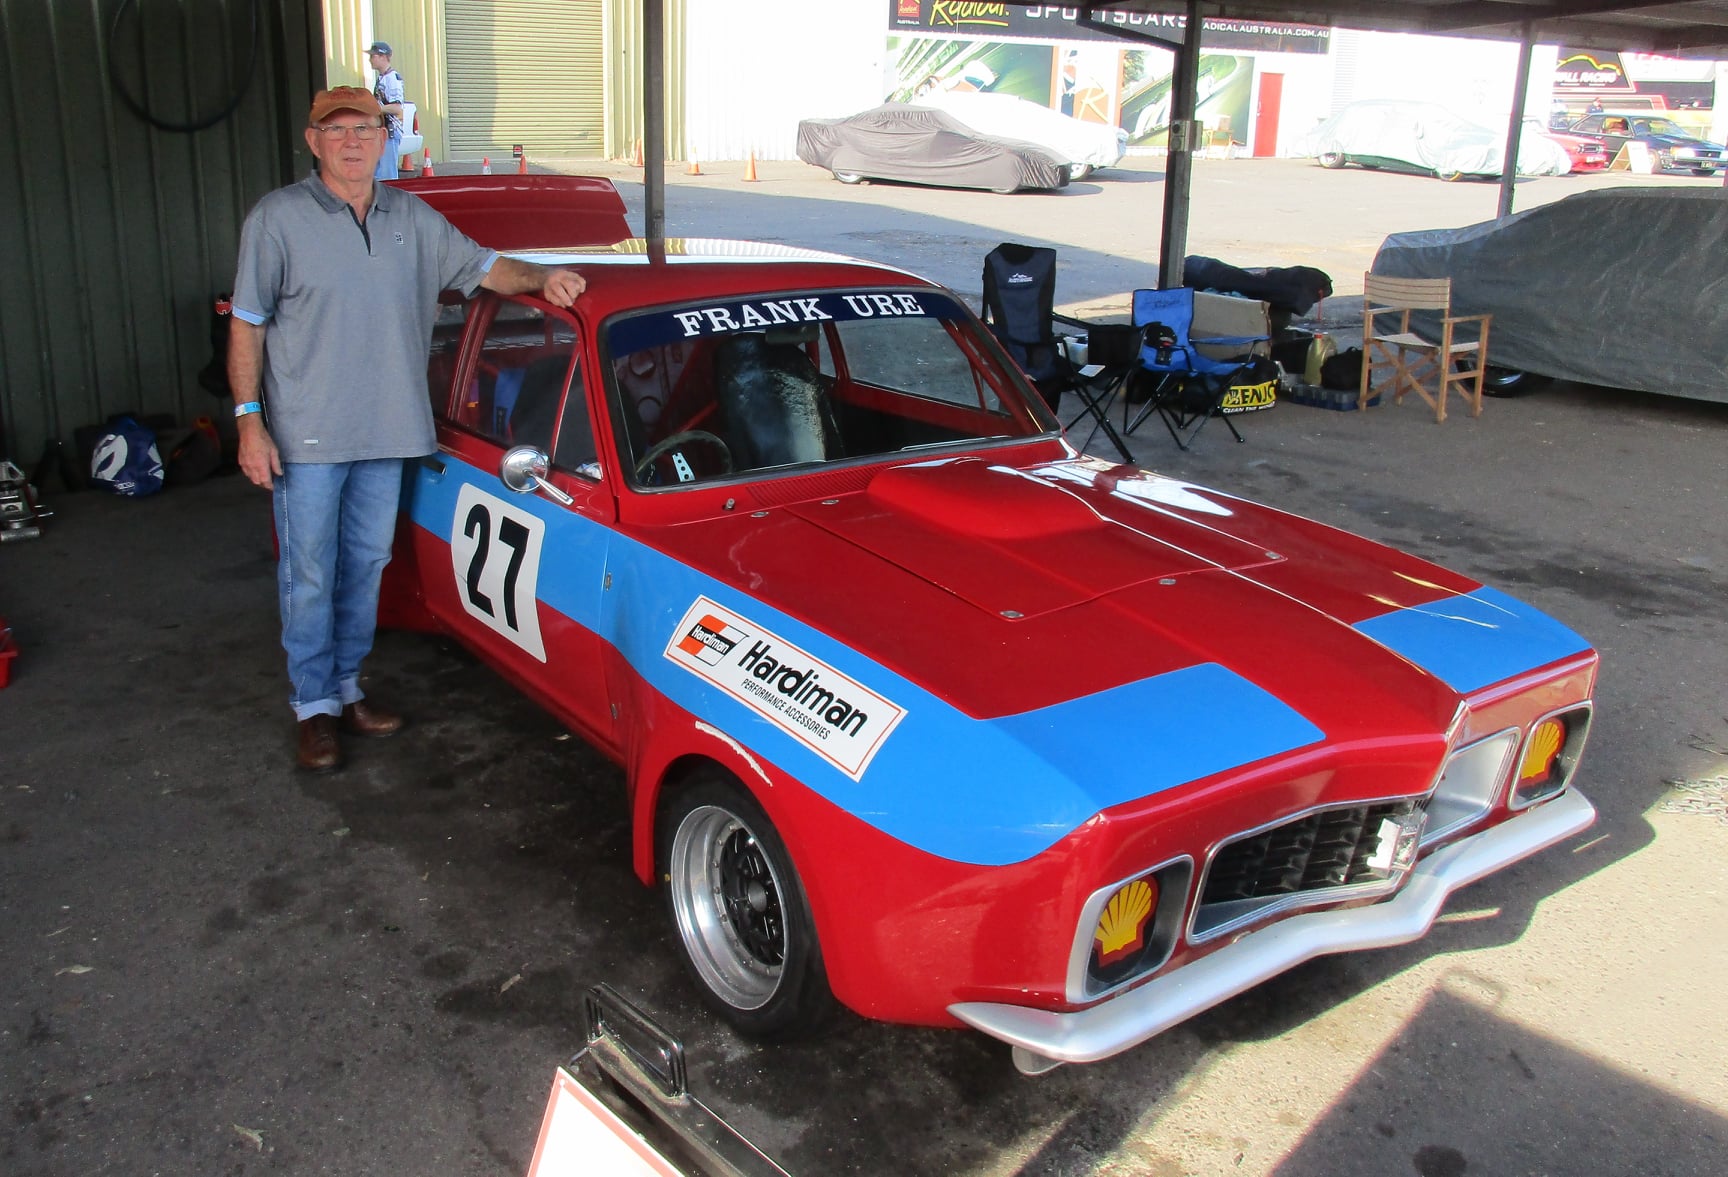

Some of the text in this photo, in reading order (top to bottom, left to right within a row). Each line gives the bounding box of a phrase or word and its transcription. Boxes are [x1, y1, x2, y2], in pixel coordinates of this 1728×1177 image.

[1202, 22, 1329, 38] ADICALAUSTRALIA.COM.AU
[673, 293, 925, 337] FRANK URE
[464, 503, 530, 632] 27
[691, 624, 730, 653] Hardiman
[737, 640, 868, 738] Hardiman
[740, 678, 831, 740] PERFORMANCE ACCESSORIES
